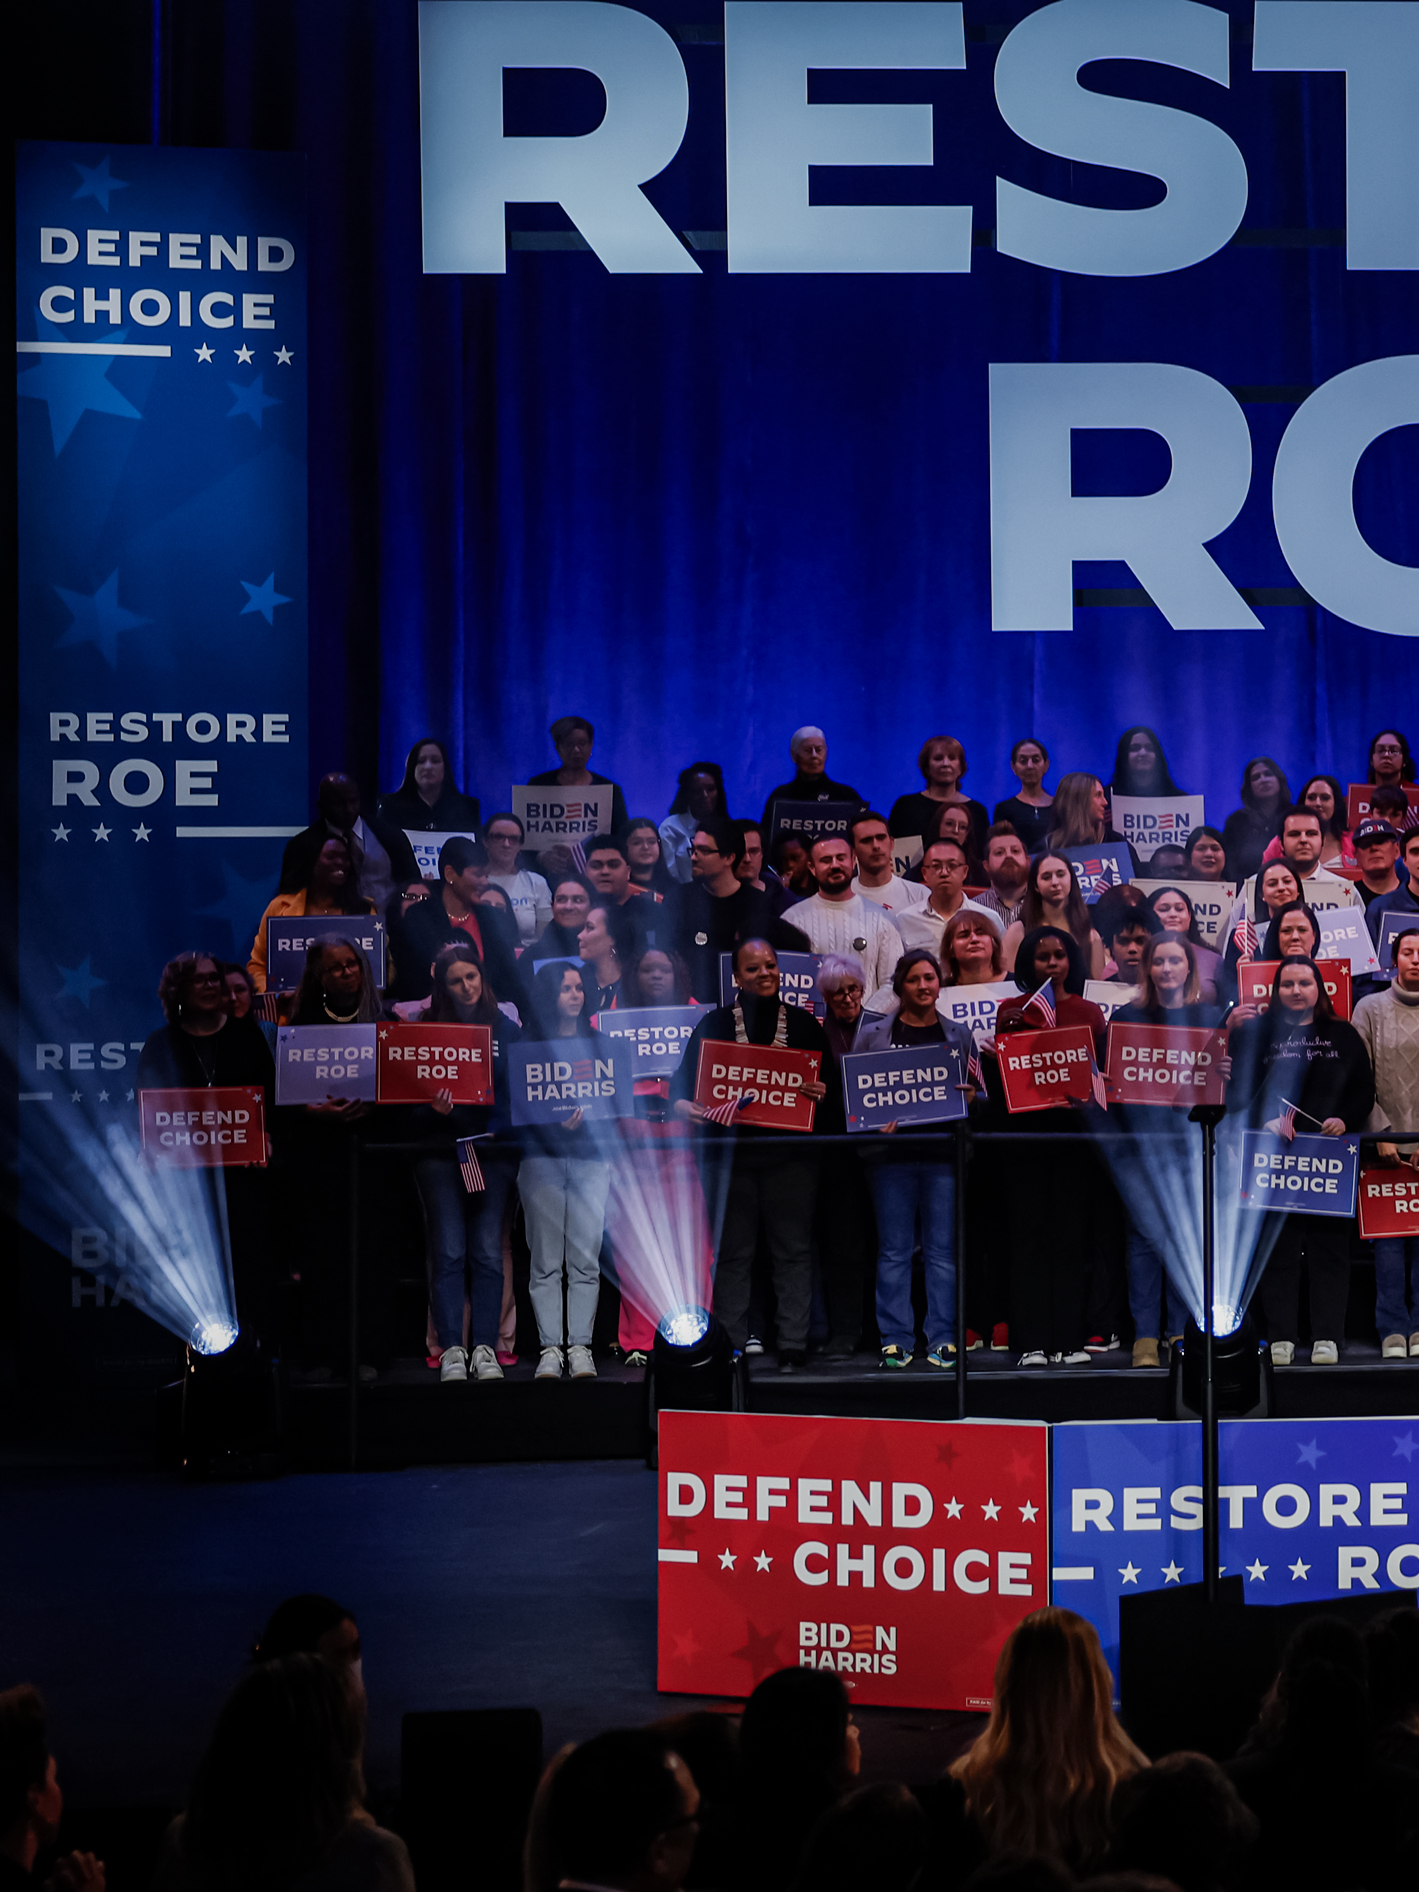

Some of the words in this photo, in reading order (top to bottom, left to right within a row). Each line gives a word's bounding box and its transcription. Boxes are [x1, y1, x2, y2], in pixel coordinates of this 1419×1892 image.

[40, 227, 295, 273] DEFEND
[39, 285, 276, 330] CHOICE
[49, 712, 290, 744] RESTORE
[52, 758, 220, 807] ROE
[526, 802, 599, 819] BIDEN
[526, 819, 598, 833] HARRIS
[780, 818, 848, 831] RESTOR
[1123, 813, 1190, 830] BIDEN
[1124, 831, 1190, 843] HARRIS
[288, 1046, 374, 1062] RESTOR
[388, 1046, 482, 1062] RESTORE
[638, 1042, 680, 1056] ROE
[1008, 1048, 1088, 1071] RESTORE
[1121, 1046, 1212, 1066] DEFEND
[315, 1064, 359, 1079] ROE
[417, 1065, 459, 1080] ROE
[526, 1058, 614, 1083] BIDEN
[712, 1064, 803, 1088] DEFEND
[857, 1066, 949, 1090] DEFEND
[1034, 1068, 1071, 1086] ROE
[1123, 1066, 1207, 1086] CHOICE
[526, 1080, 616, 1101] HARRIS
[712, 1084, 797, 1108] CHOICE
[862, 1086, 947, 1109] CHOICE
[155, 1109, 251, 1126] DEFEND
[159, 1129, 248, 1146] CHOICE
[1254, 1153, 1343, 1174] DEFEND
[1255, 1173, 1338, 1194] CHOICE
[667, 1471, 934, 1529] DEFEND
[1071, 1482, 1409, 1532] RESTORE
[793, 1541, 1033, 1596] CHOICE
[799, 1621, 897, 1651] BIDEN
[799, 1649, 897, 1675] HARRIS
